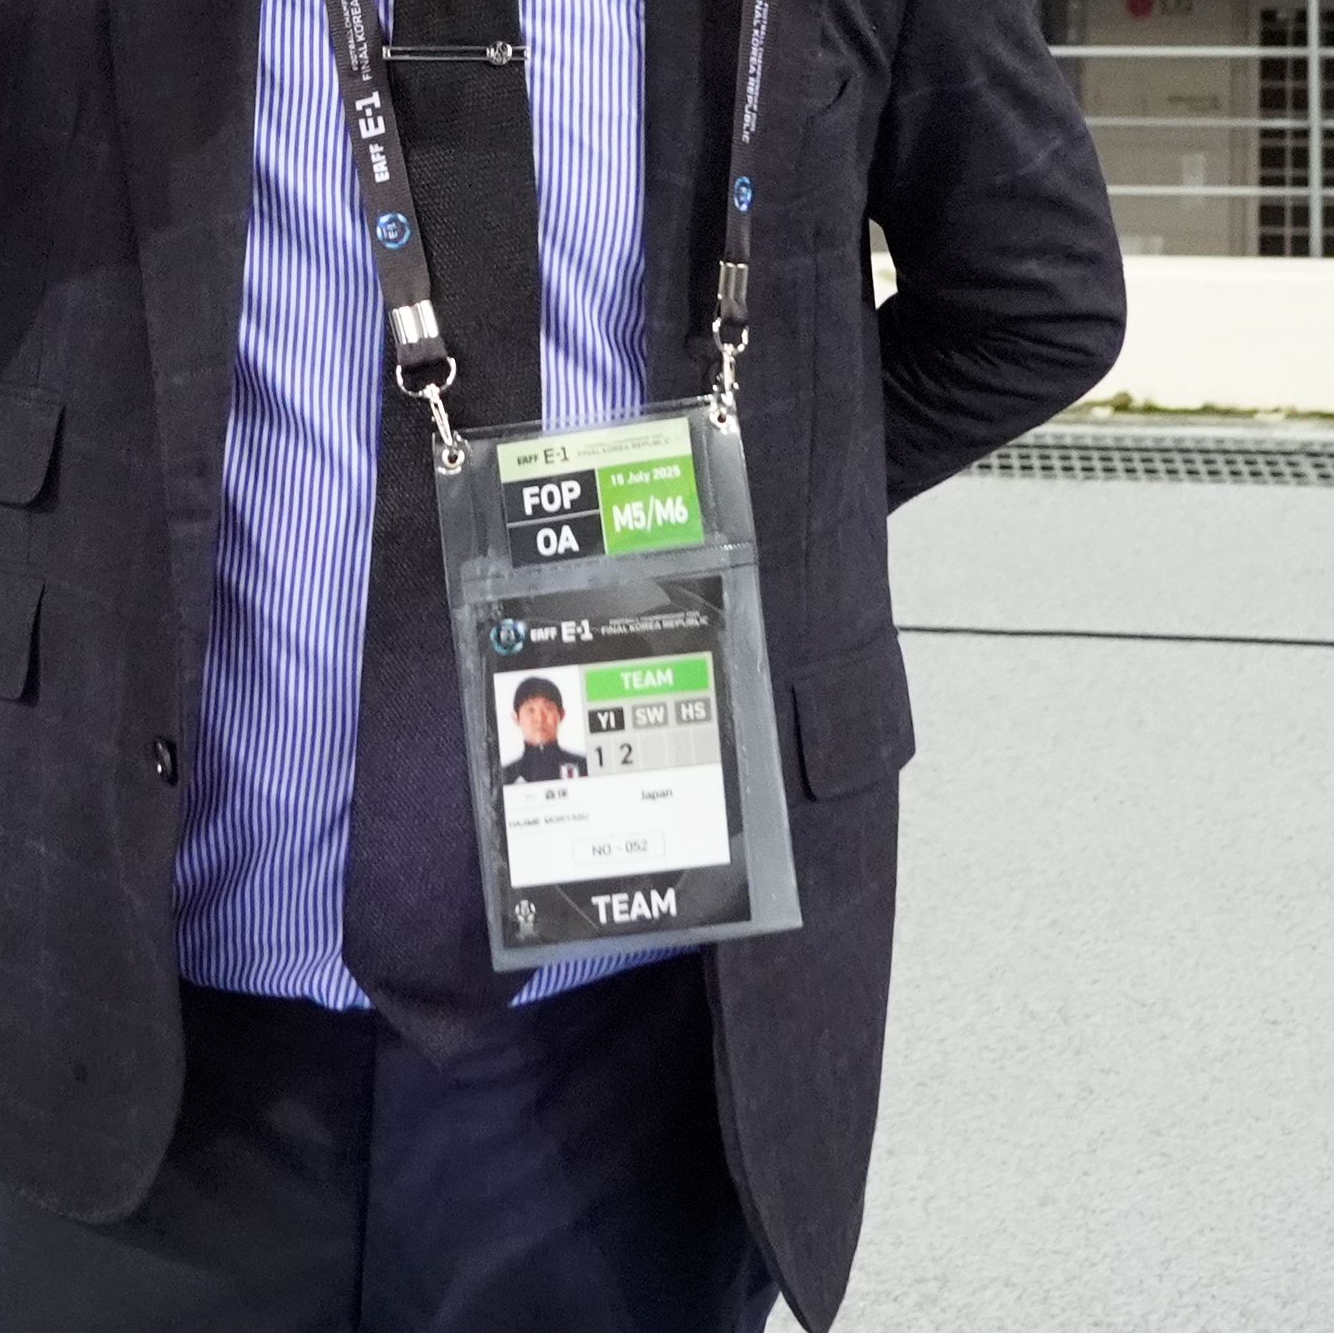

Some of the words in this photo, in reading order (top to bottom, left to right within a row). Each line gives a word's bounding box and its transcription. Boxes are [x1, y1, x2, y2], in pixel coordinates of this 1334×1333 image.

[351, 1, 367, 45] KOREA
[358, 45, 371, 82] FINAL
[370, 144, 391, 183] EAFF
[517, 453, 540, 466] EAFF
[628, 469, 652, 484] July
[522, 480, 582, 516] FOP
[612, 495, 689, 533] M5/M6
[536, 524, 581, 557] OA
[530, 626, 558, 643] EAFF
[620, 668, 673, 691] TEAM
[596, 711, 616, 730] YI
[633, 706, 664, 727] SW
[681, 701, 706, 721] HS
[595, 746, 605, 767] 1
[620, 743, 634, 765] 2
[642, 788, 673, 801] Japan
[591, 886, 677, 925] TEAM
